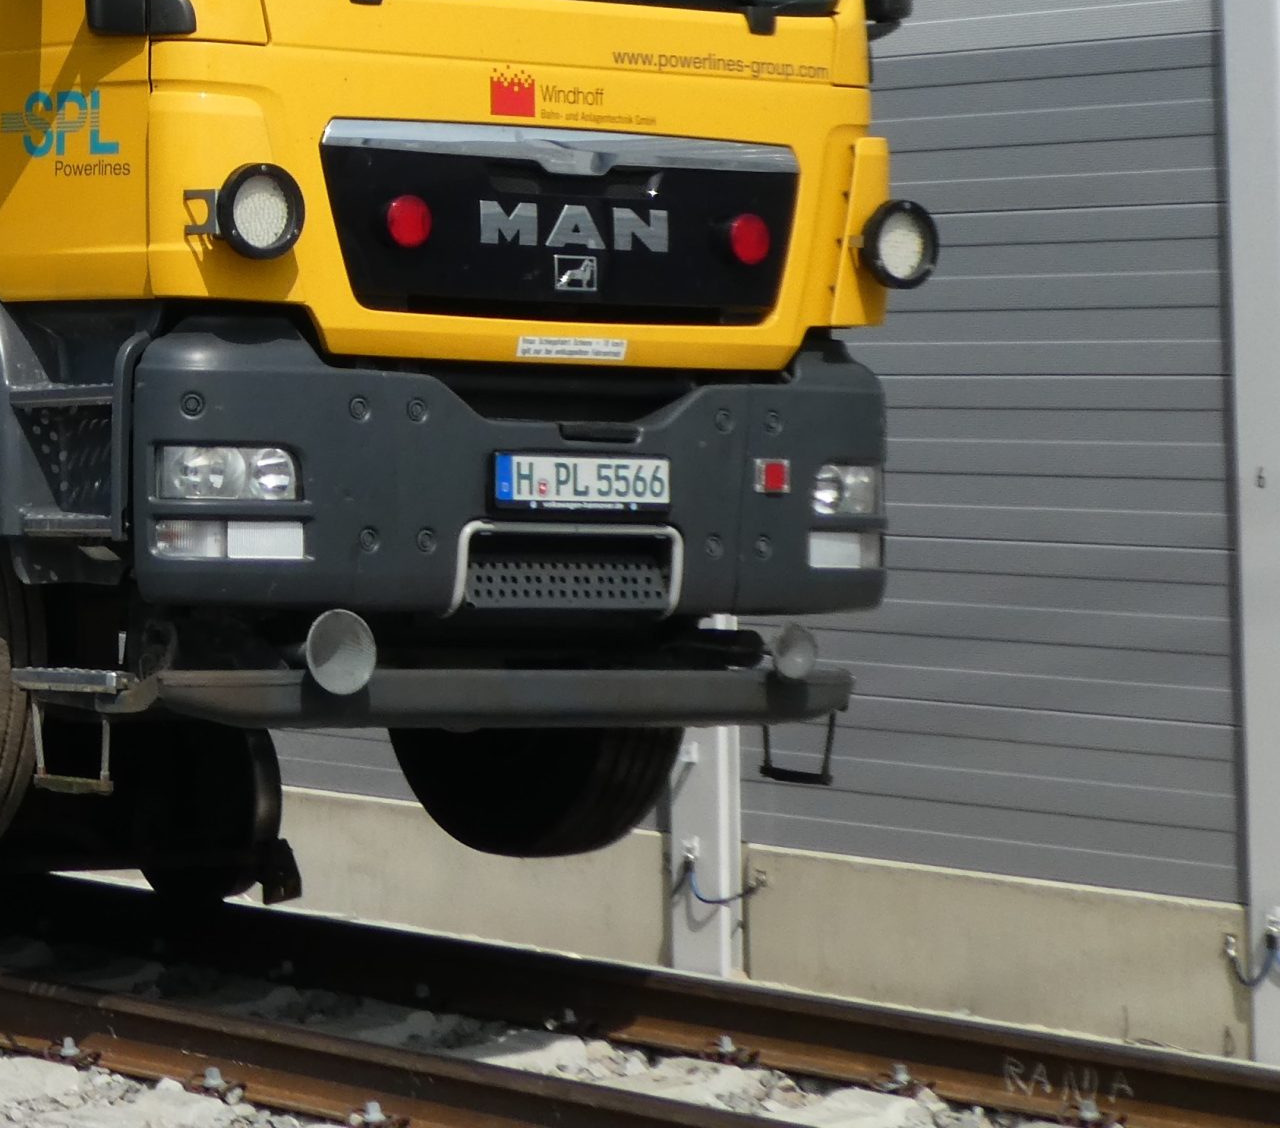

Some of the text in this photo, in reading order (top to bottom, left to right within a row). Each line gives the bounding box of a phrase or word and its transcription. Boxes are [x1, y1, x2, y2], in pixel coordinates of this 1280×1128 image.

[612, 50, 829, 79] www.powerlines-group.com
[540, 84, 604, 106] Windhoff
[23, 89, 120, 157] SPL
[54, 160, 131, 177] Powerlines
[479, 199, 669, 253] MAN
[516, 461, 665, 498] H PL 5566
